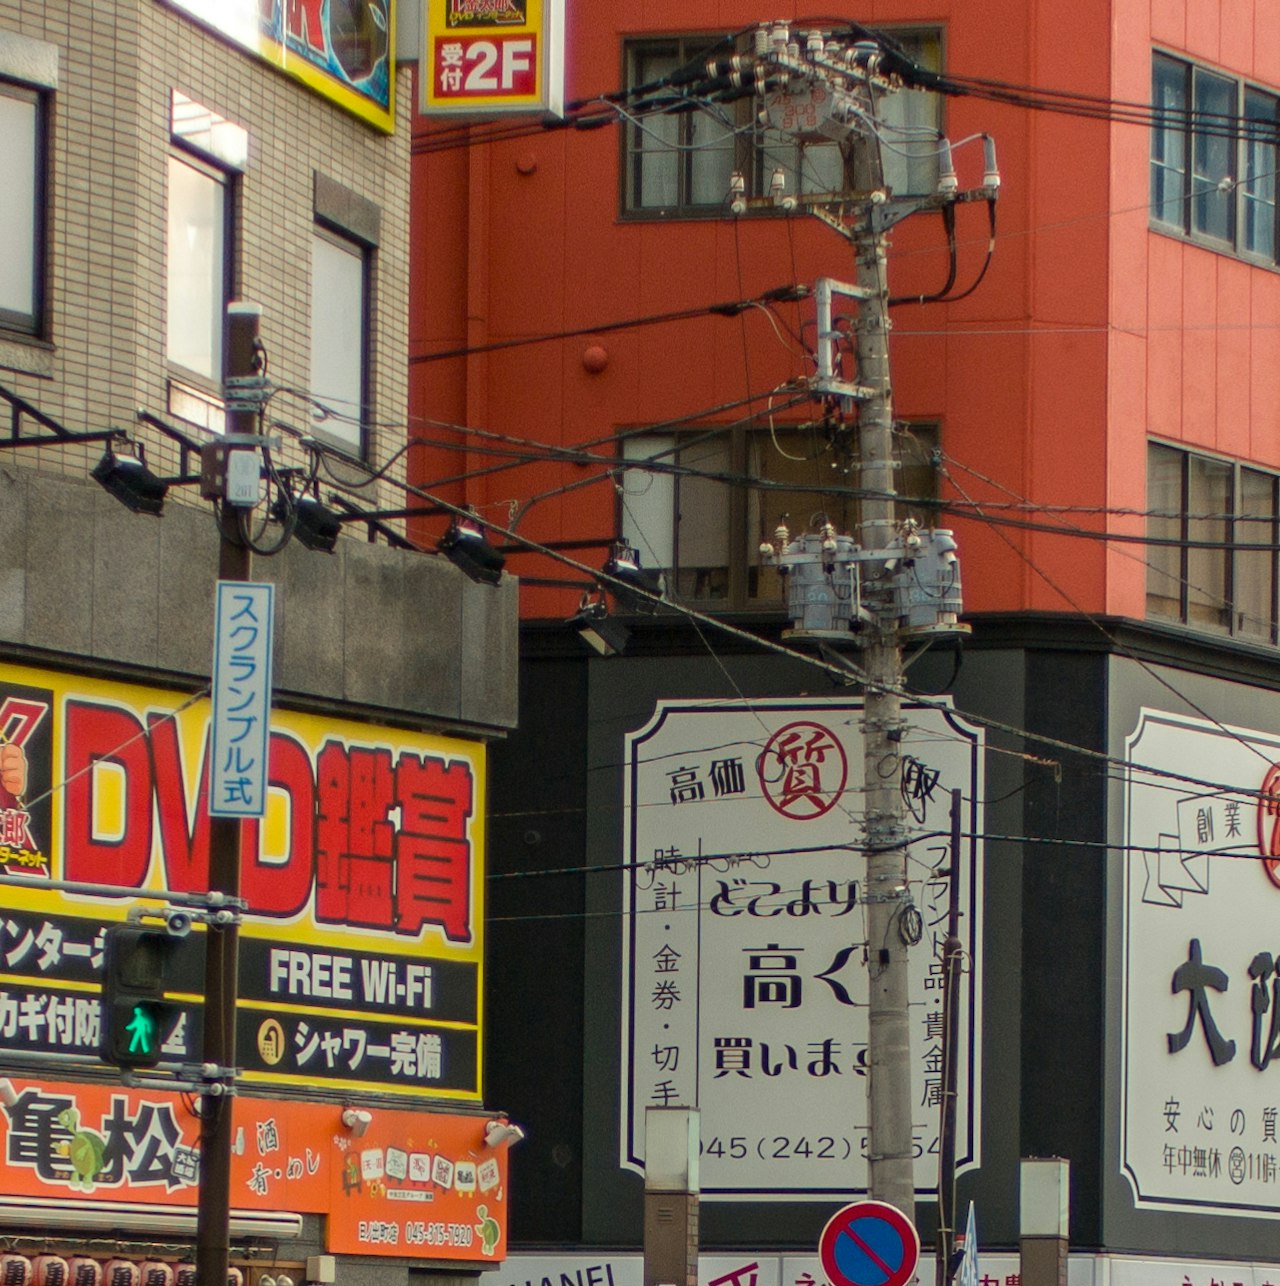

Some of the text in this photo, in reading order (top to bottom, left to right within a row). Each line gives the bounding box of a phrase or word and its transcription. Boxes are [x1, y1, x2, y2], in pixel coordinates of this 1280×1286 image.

[440, 39, 532, 93] 受付 2F
[223, 594, 260, 806] スクランブル式
[665, 756, 746, 807] 高価
[770, 728, 837, 815] 質
[1196, 801, 1242, 845] 創業
[270, 949, 433, 1010] FREE Wi-Fi
[294, 1020, 441, 1080] シャワー完備
[257, 1117, 281, 1156] 酒
[1162, 1143, 1222, 1179] 年中無休
